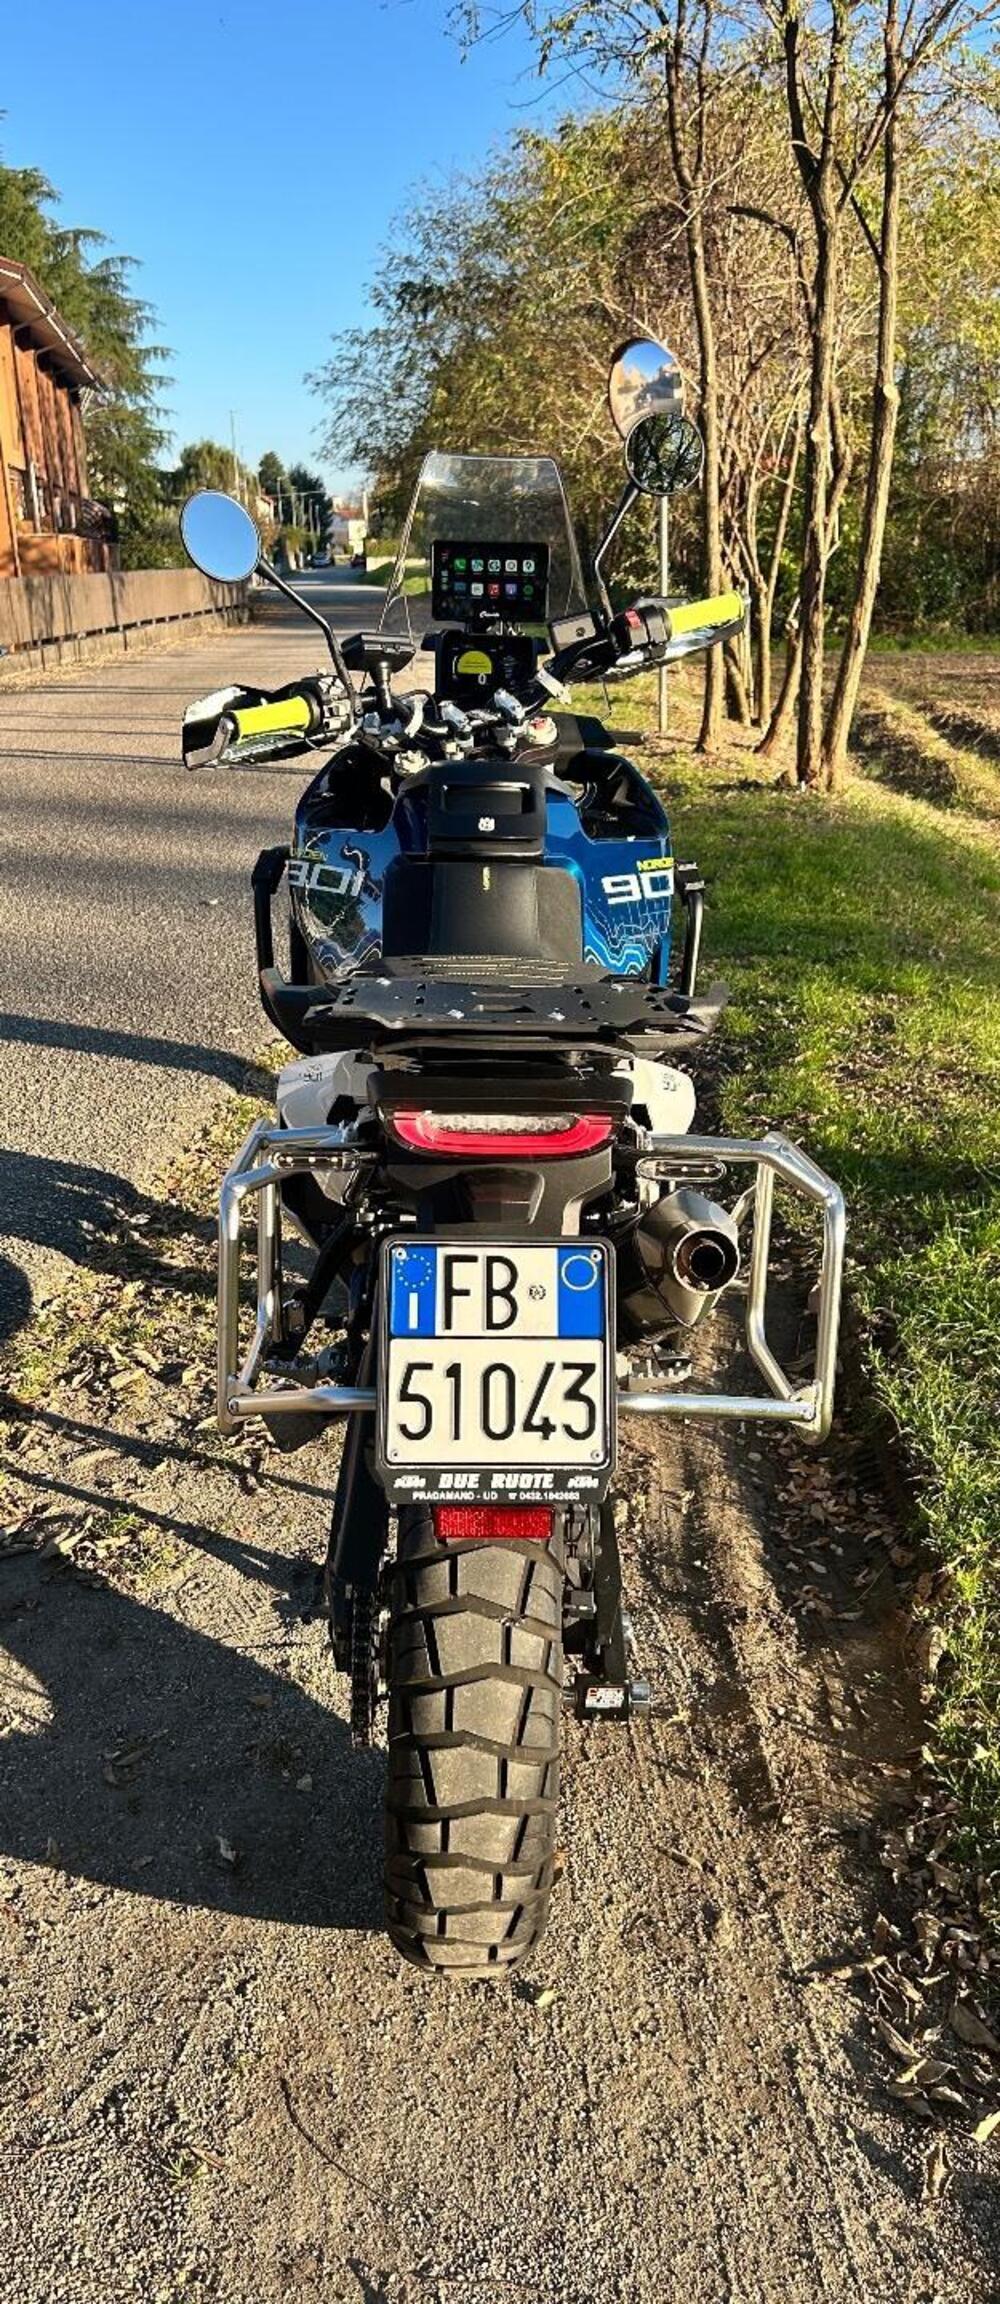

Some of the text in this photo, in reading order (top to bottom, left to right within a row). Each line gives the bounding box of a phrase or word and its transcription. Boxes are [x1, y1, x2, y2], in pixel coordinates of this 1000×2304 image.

[443, 1254, 519, 1330] FB
[398, 1361, 597, 1441] 51043
[438, 1473, 481, 1488] DUE
[490, 1473, 555, 1488] RUOTE
[483, 1491, 499, 1501] UD
